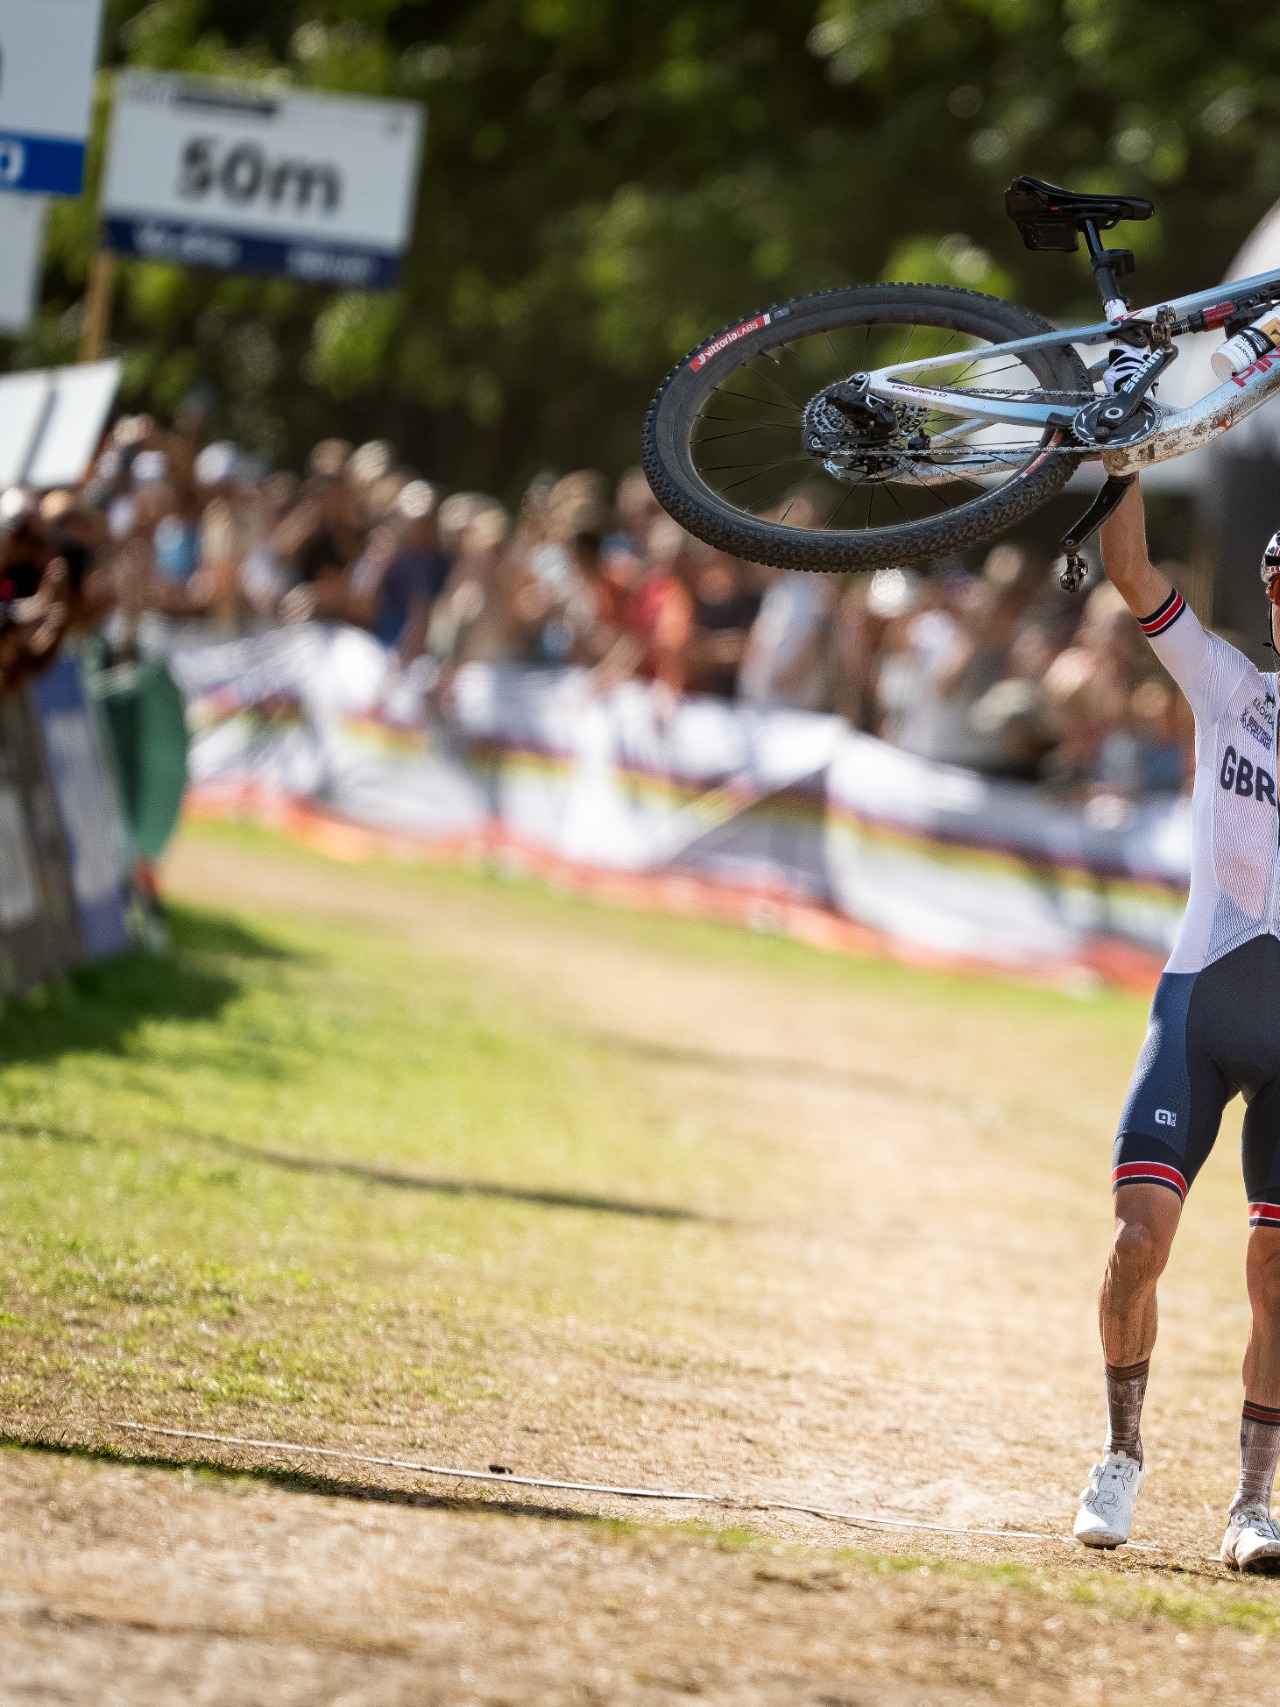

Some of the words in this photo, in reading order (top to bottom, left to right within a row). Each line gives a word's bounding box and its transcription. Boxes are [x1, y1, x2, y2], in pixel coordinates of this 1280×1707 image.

[179, 137, 341, 215] 50m
[1122, 348, 1164, 394] SRAM
[891, 384, 948, 397] PINARELLO
[1246, 723, 1271, 750] CYCLING
[1249, 715, 1273, 743] BRITISH
[1220, 745, 1277, 807] GBR
